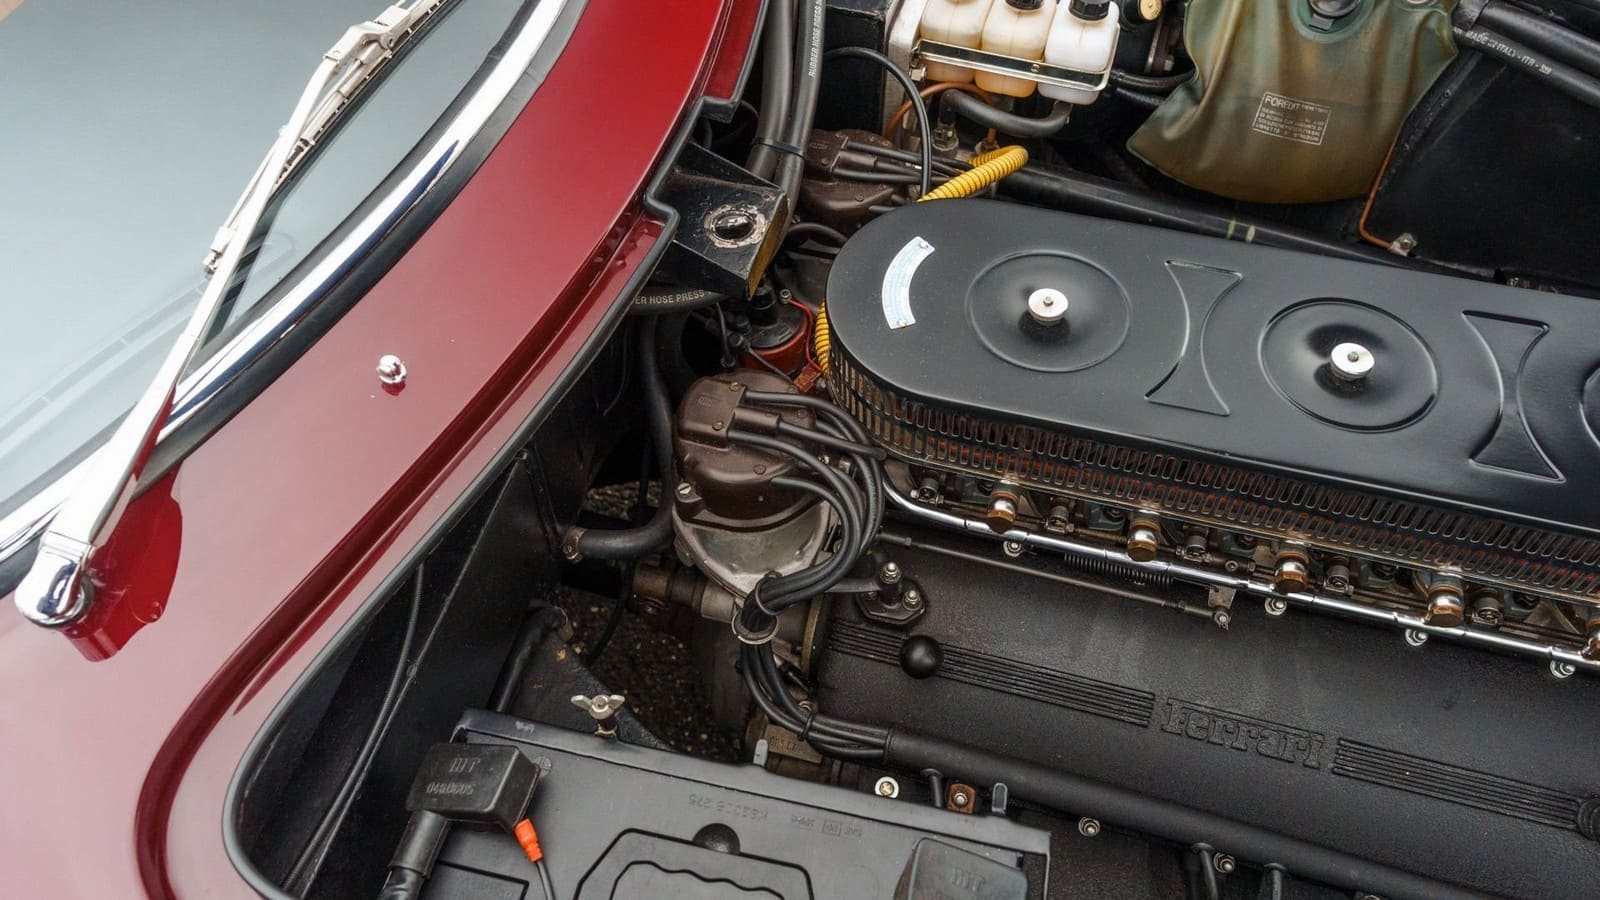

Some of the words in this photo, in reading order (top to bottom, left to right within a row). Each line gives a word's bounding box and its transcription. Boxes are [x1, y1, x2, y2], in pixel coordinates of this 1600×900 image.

[1465, 30, 1489, 45] MADE
[649, 294, 674, 304] HOSE
[676, 289, 706, 302] PRESS
[1161, 697, 1325, 770] Ferrari
